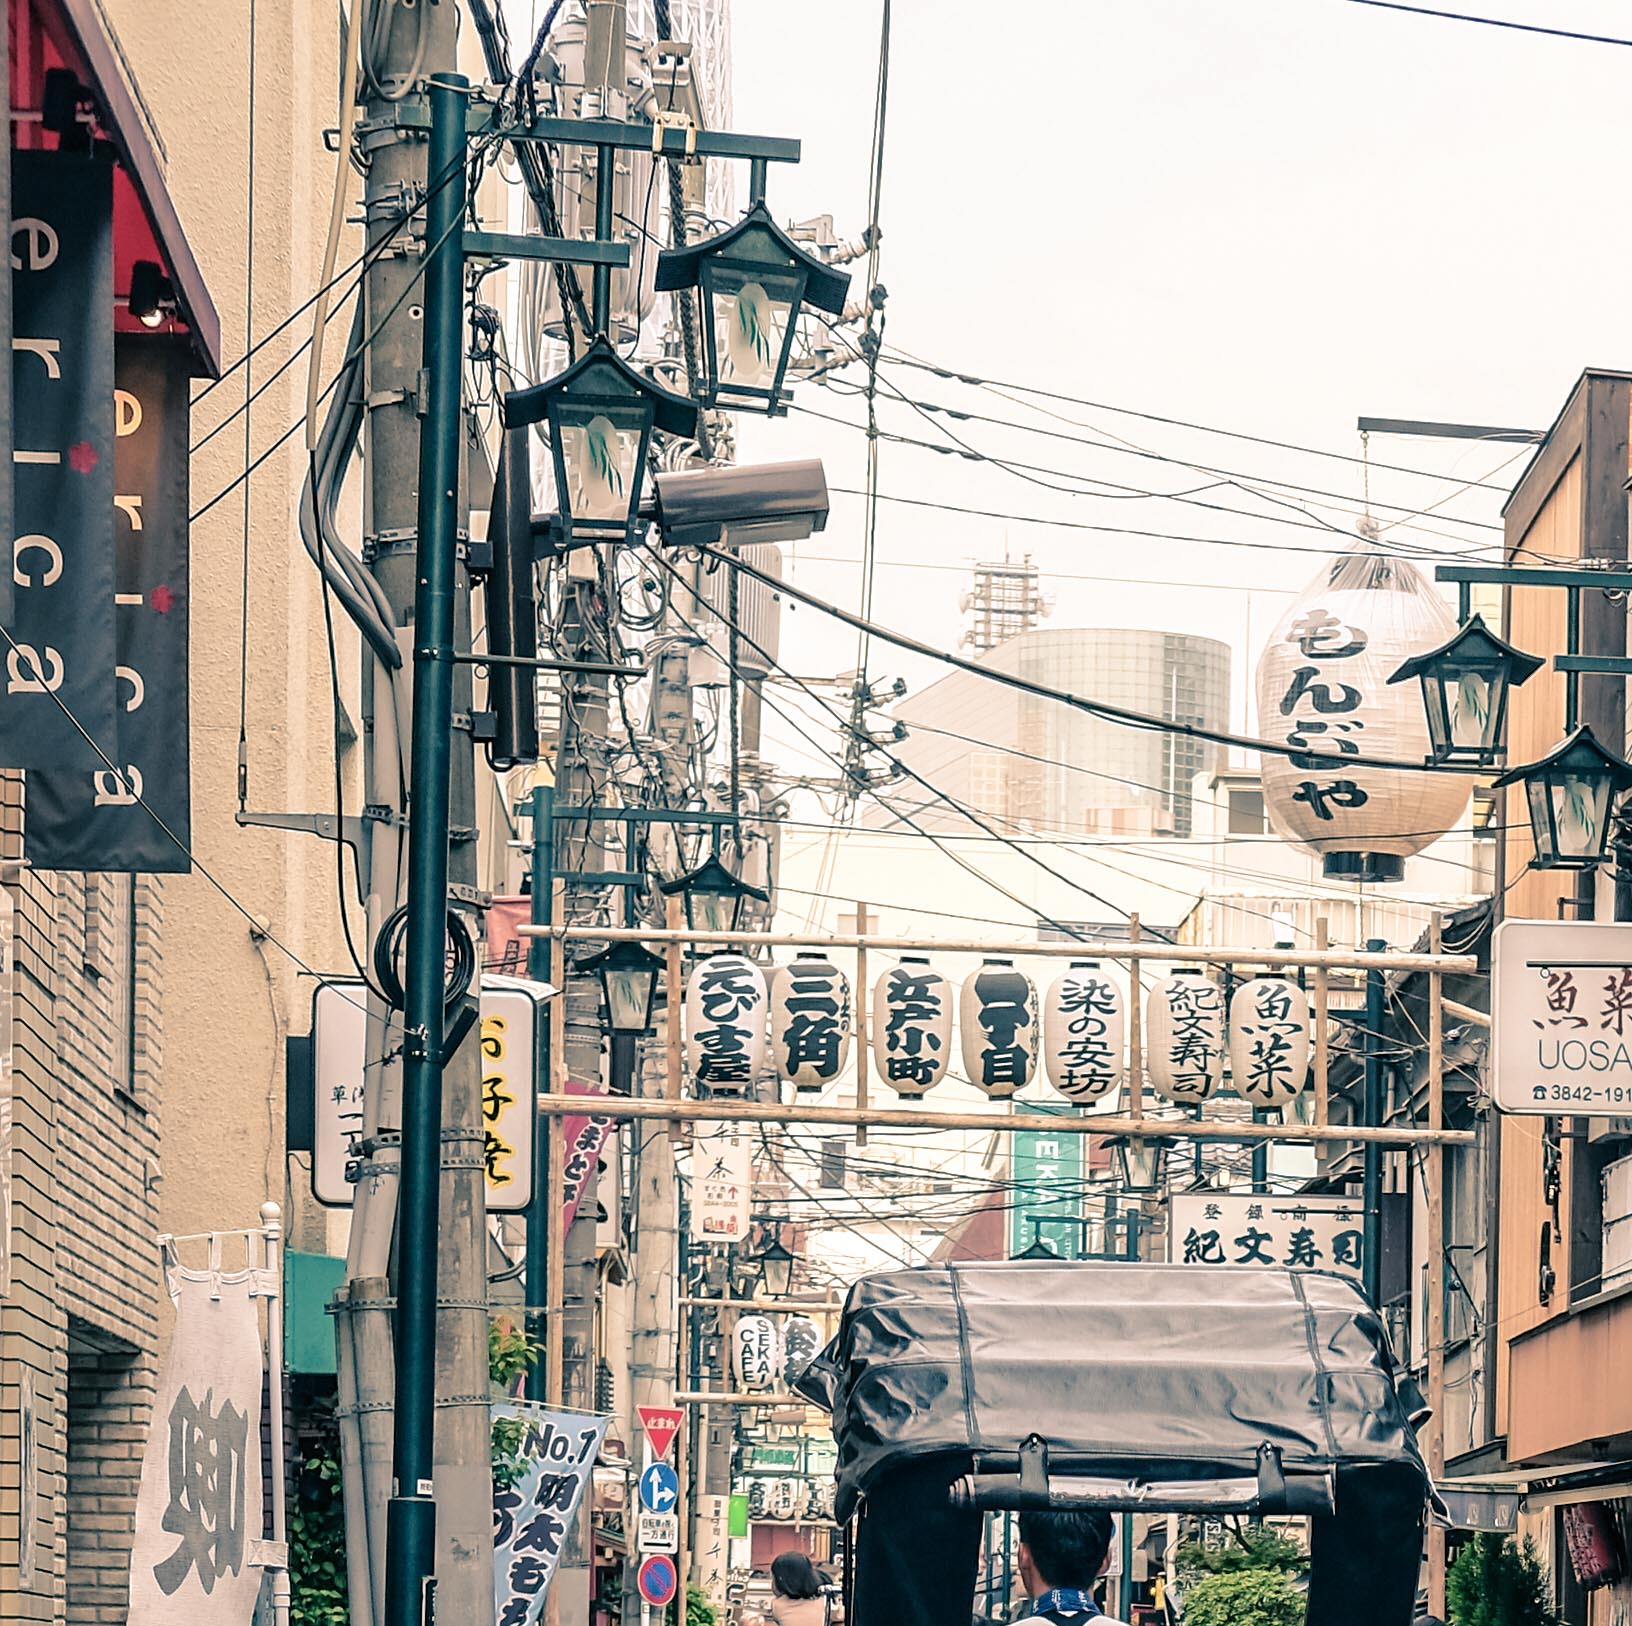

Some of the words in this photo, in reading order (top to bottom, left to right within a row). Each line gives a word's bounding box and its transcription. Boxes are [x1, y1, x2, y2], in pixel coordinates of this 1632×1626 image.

[782, 965, 843, 1077] 三角
[1057, 979, 1117, 1095] 染の安坊
[1165, 980, 1221, 1098] 紀文寿司
[1240, 984, 1303, 1099] 魚菜
[1183, 1226, 1363, 1270] 紀文寿司
[740, 1329, 756, 1383] CAFE
[756, 1319, 770, 1384] SEKAI
[522, 1422, 598, 1466] No.1
[647, 1416, 676, 1430] 止まれ
